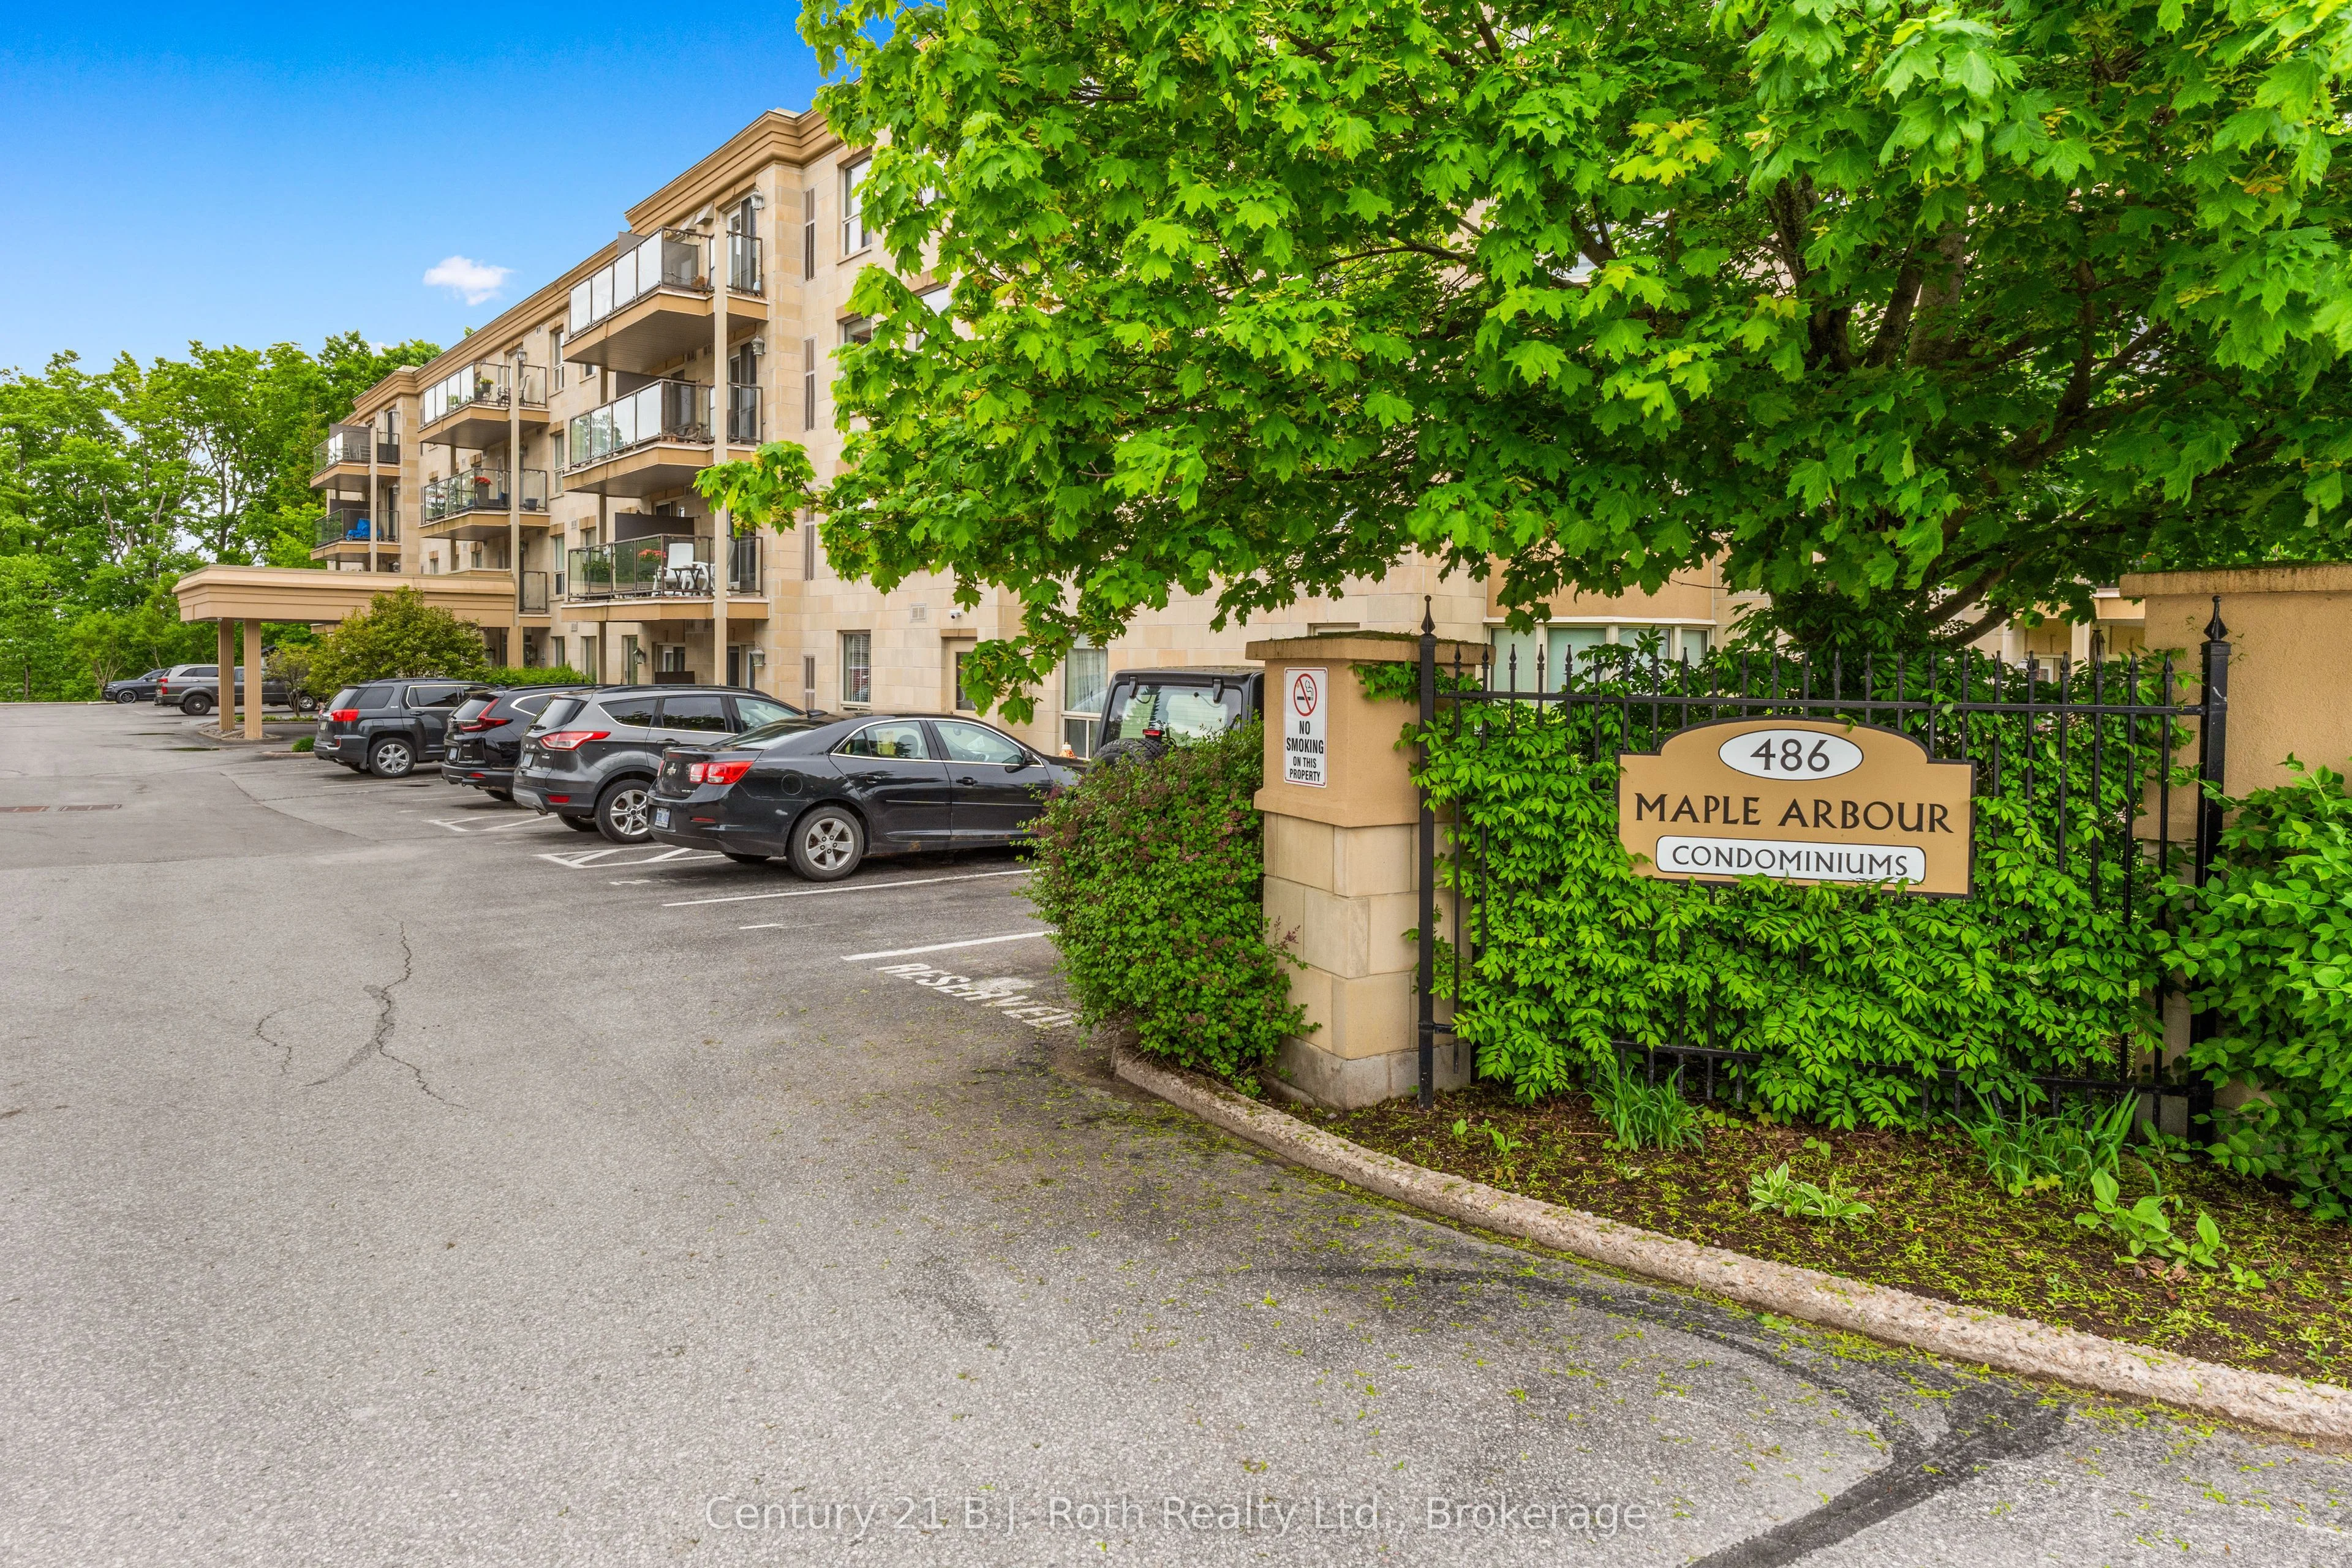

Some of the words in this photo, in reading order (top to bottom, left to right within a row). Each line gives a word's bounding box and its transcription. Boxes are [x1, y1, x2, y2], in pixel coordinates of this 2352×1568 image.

[1299, 720, 1310, 734] NO
[1286, 737, 1324, 754] SMOKING
[1293, 756, 1301, 766] ON
[1303, 757, 1317, 768] THIS
[1750, 737, 1830, 772] 486
[1289, 768, 1321, 782] PROPERTY
[1635, 793, 1762, 826] MAPLE
[1777, 799, 1954, 834] ARBOUR
[1672, 845, 1908, 877] CONDOMINIUMS
